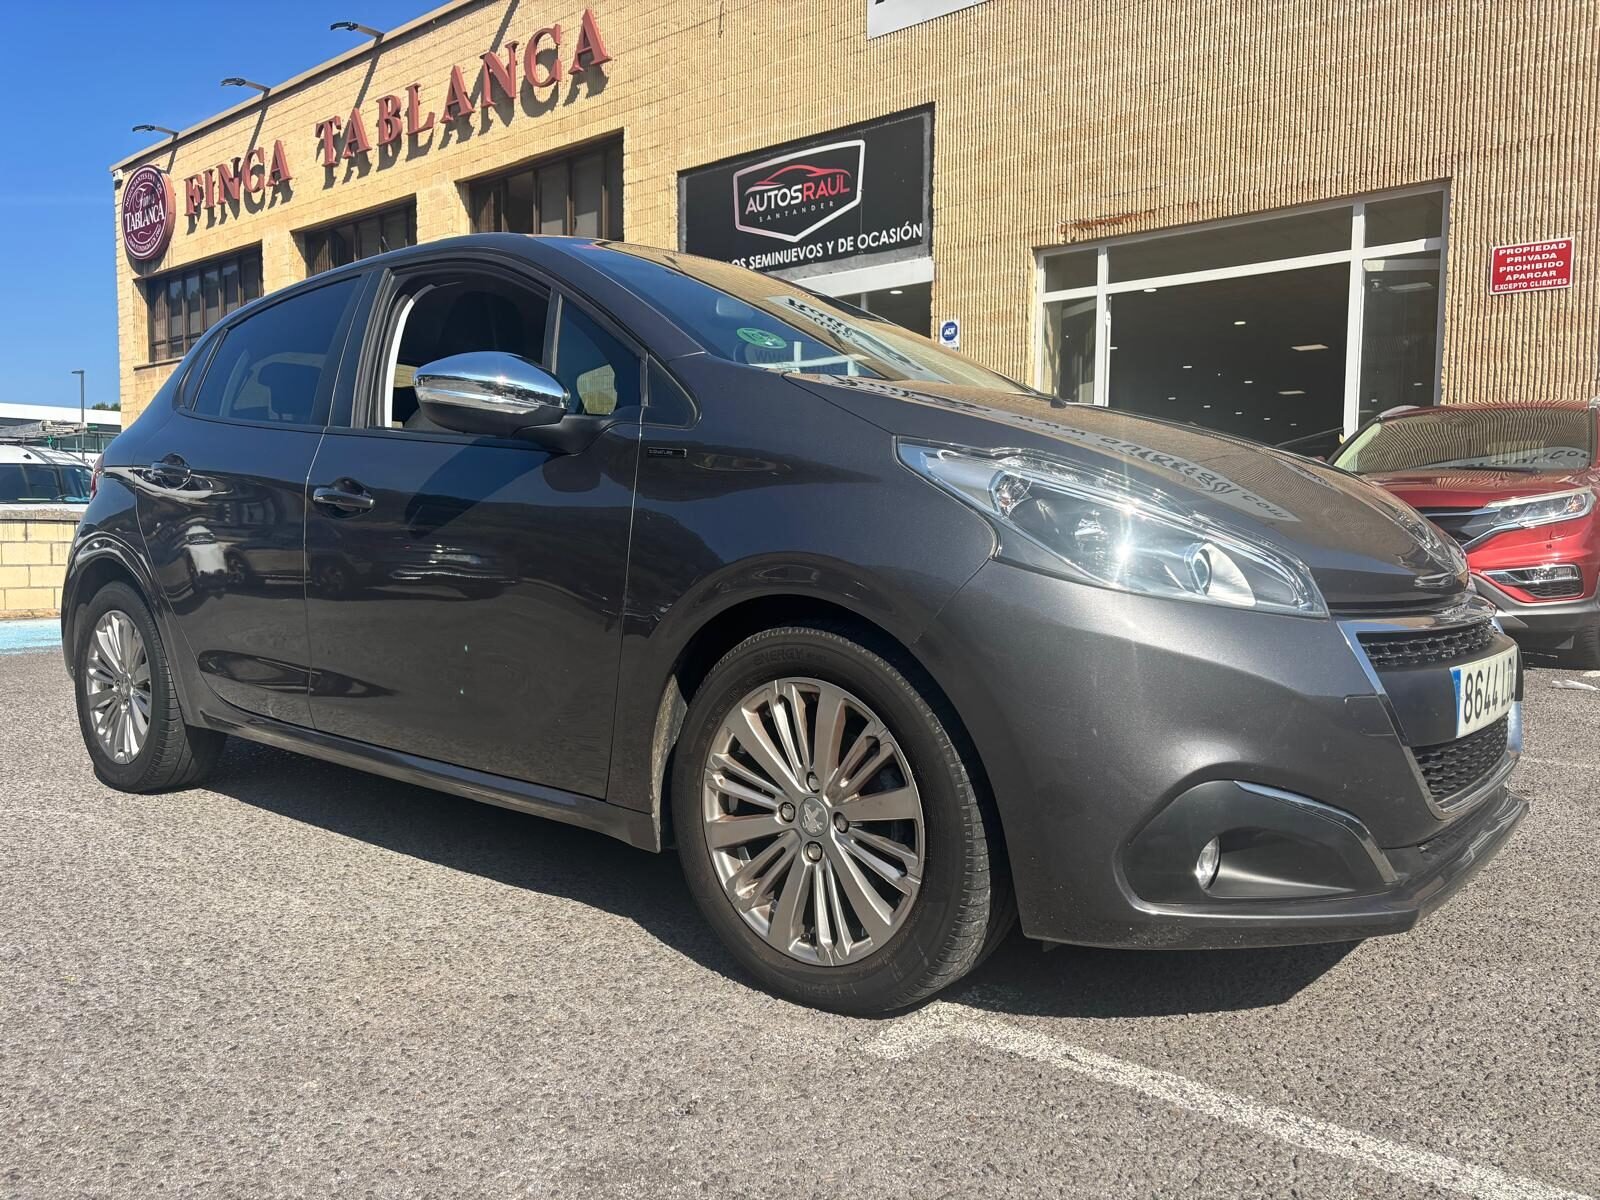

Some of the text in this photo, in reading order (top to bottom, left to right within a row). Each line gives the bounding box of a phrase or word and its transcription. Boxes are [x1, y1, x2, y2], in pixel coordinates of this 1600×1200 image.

[184, 8, 613, 217] FINCA TABLANCA
[124, 199, 165, 233] TABLANCA
[759, 200, 835, 223] SANTANDER
[749, 243, 823, 270] SEMINUEVOS
[827, 241, 835, 255] Y
[838, 236, 854, 253] DE
[858, 220, 923, 250] OCASIÓN
[1499, 242, 1567, 256] PROPIEDAD
[1499, 260, 1564, 273] PROHIBIDO
[1506, 252, 1558, 263] PRIVADA
[1494, 278, 1568, 291] EXCEPTO CLIENTES
[1505, 270, 1557, 281] APARCAR
[1463, 663, 1498, 724] 8644
